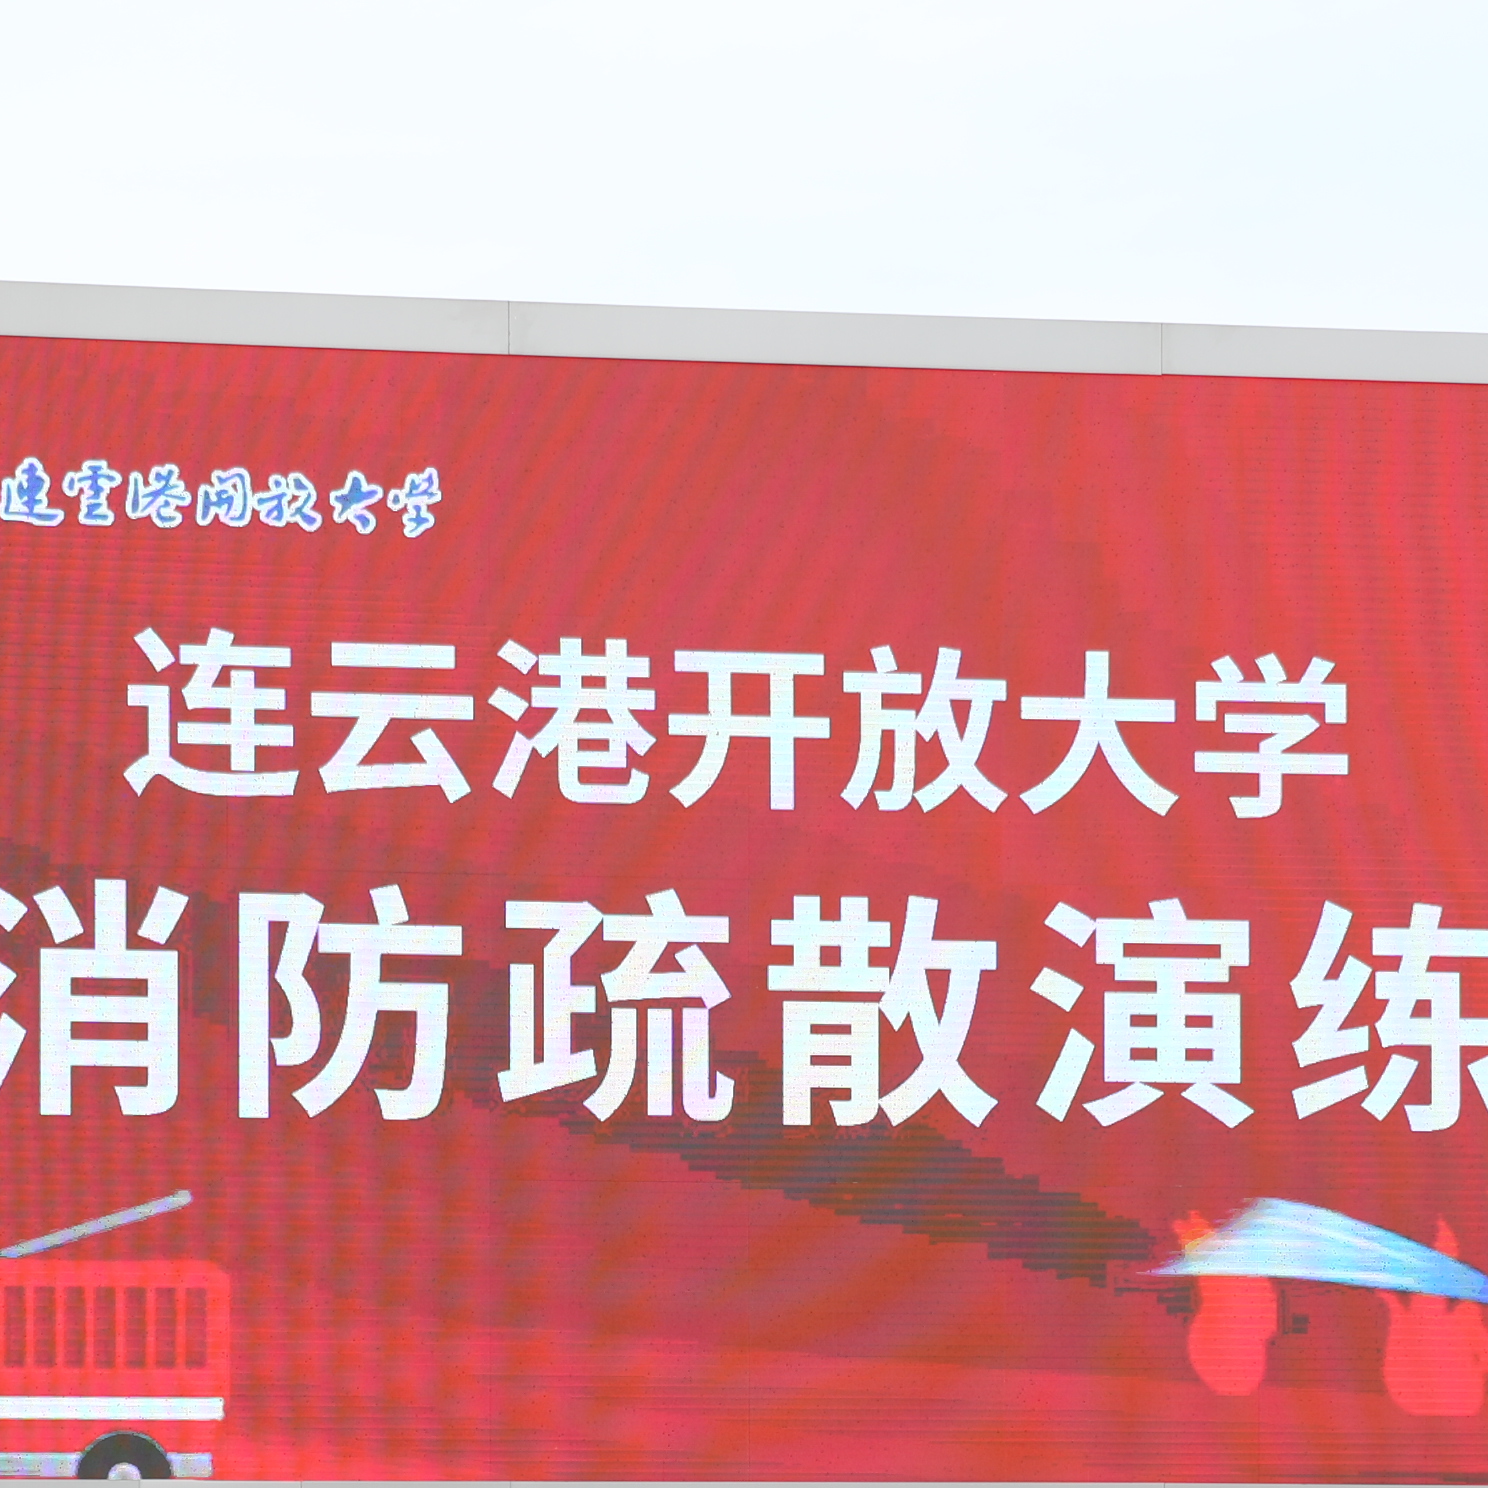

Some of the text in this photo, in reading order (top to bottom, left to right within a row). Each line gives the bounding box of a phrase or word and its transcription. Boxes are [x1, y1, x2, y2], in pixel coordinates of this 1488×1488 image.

[124, 628, 1349, 819] 连云港开放大学
